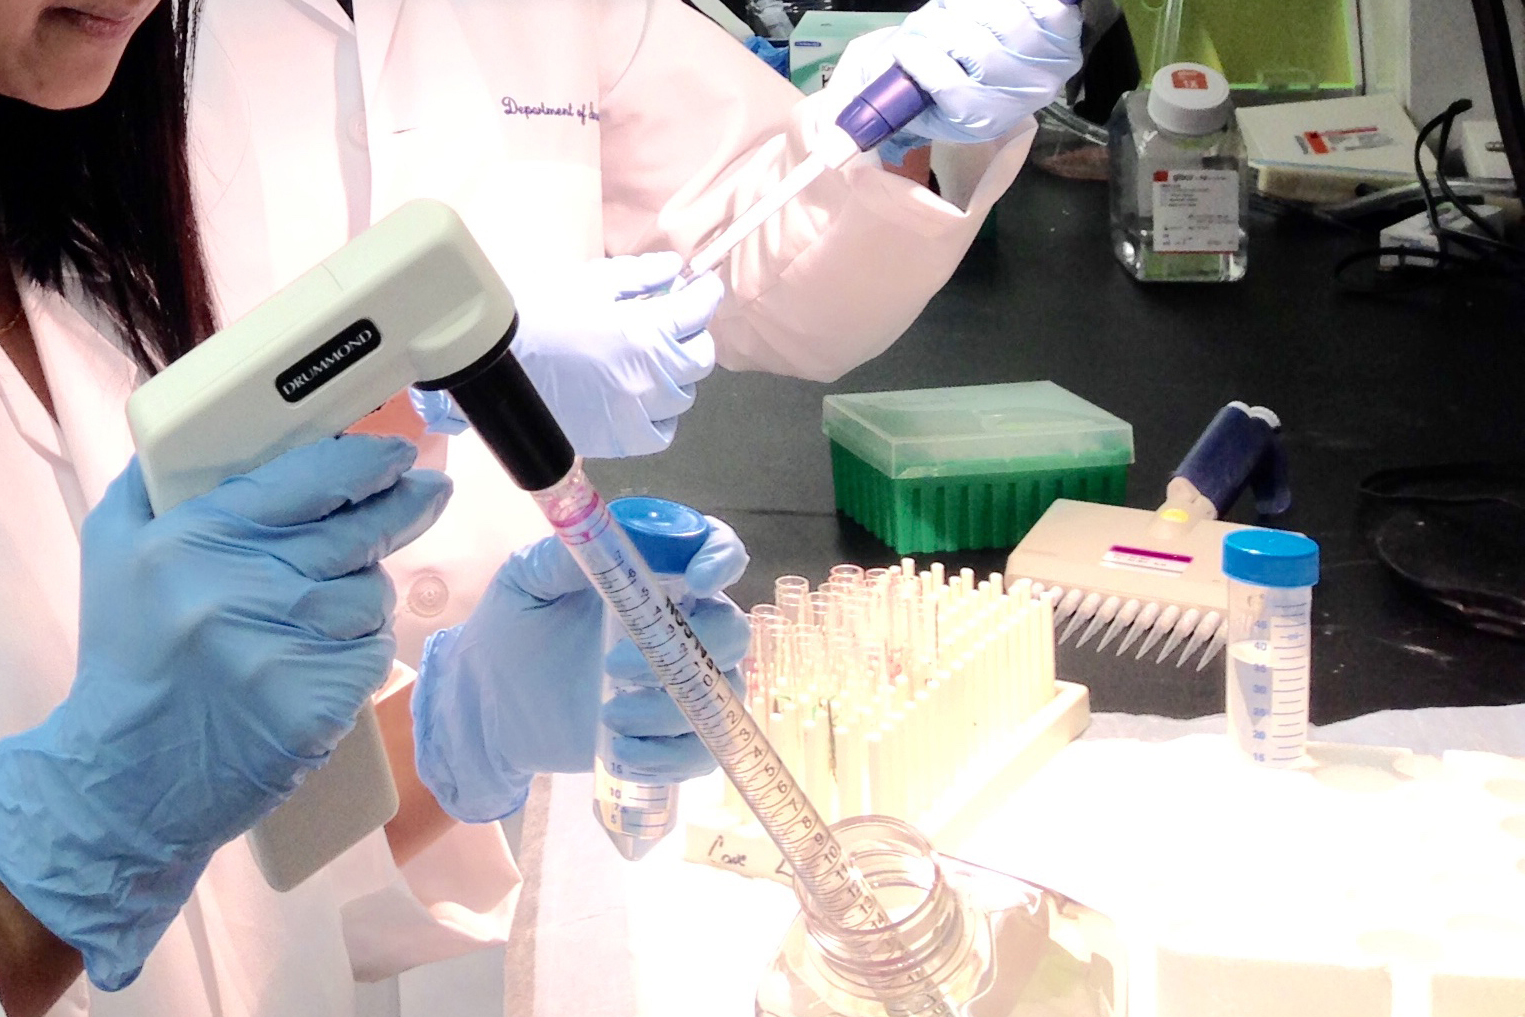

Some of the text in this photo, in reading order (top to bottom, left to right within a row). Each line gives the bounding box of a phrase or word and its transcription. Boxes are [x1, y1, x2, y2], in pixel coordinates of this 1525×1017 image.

[501, 96, 574, 120] Department
[577, 103, 587, 126] of
[282, 329, 373, 395] DRUMMOND
[1254, 642, 1267, 651] 40
[702, 674, 713, 687] 0
[716, 692, 725, 704] 1
[726, 710, 738, 725] 2
[739, 727, 750, 742] 3
[752, 745, 763, 759] 4
[611, 761, 623, 774] 15
[764, 762, 775, 777] 5
[610, 787, 622, 800] 10
[777, 780, 788, 794] 6
[789, 797, 799, 812] 7
[801, 815, 812, 829] 8
[814, 832, 824, 846] 9
[823, 845, 839, 865] 10
[835, 862, 849, 881] 11
[847, 879, 861, 898] 12
[859, 895, 874, 914] 13
